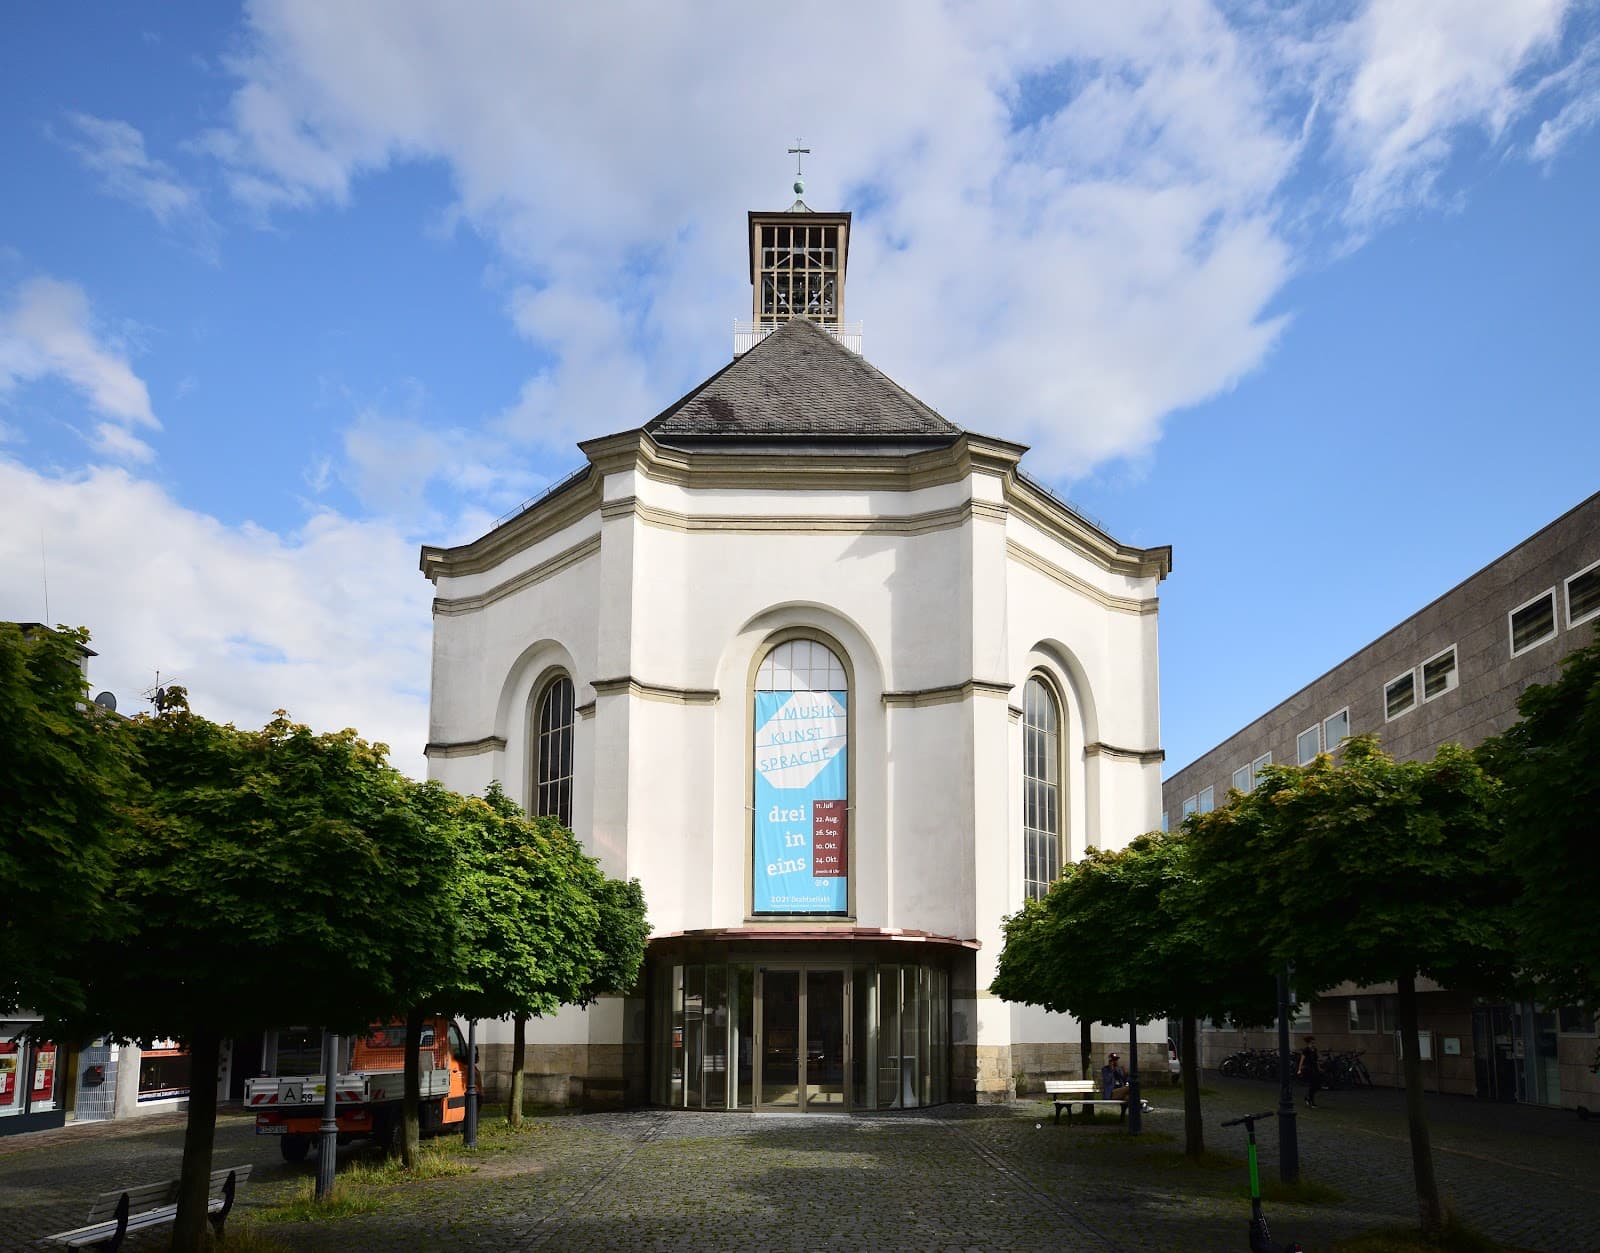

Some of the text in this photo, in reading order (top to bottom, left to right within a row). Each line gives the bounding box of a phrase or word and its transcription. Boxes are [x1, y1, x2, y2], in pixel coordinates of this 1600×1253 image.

[784, 705, 836, 719] MUSIK
[771, 727, 822, 745] KUNST
[760, 747, 831, 771] SPRACHE
[768, 805, 806, 823] drei
[824, 815, 839, 824] Aug.
[785, 831, 806, 848] in
[767, 857, 806, 876] eins
[284, 1087, 296, 1101] A
